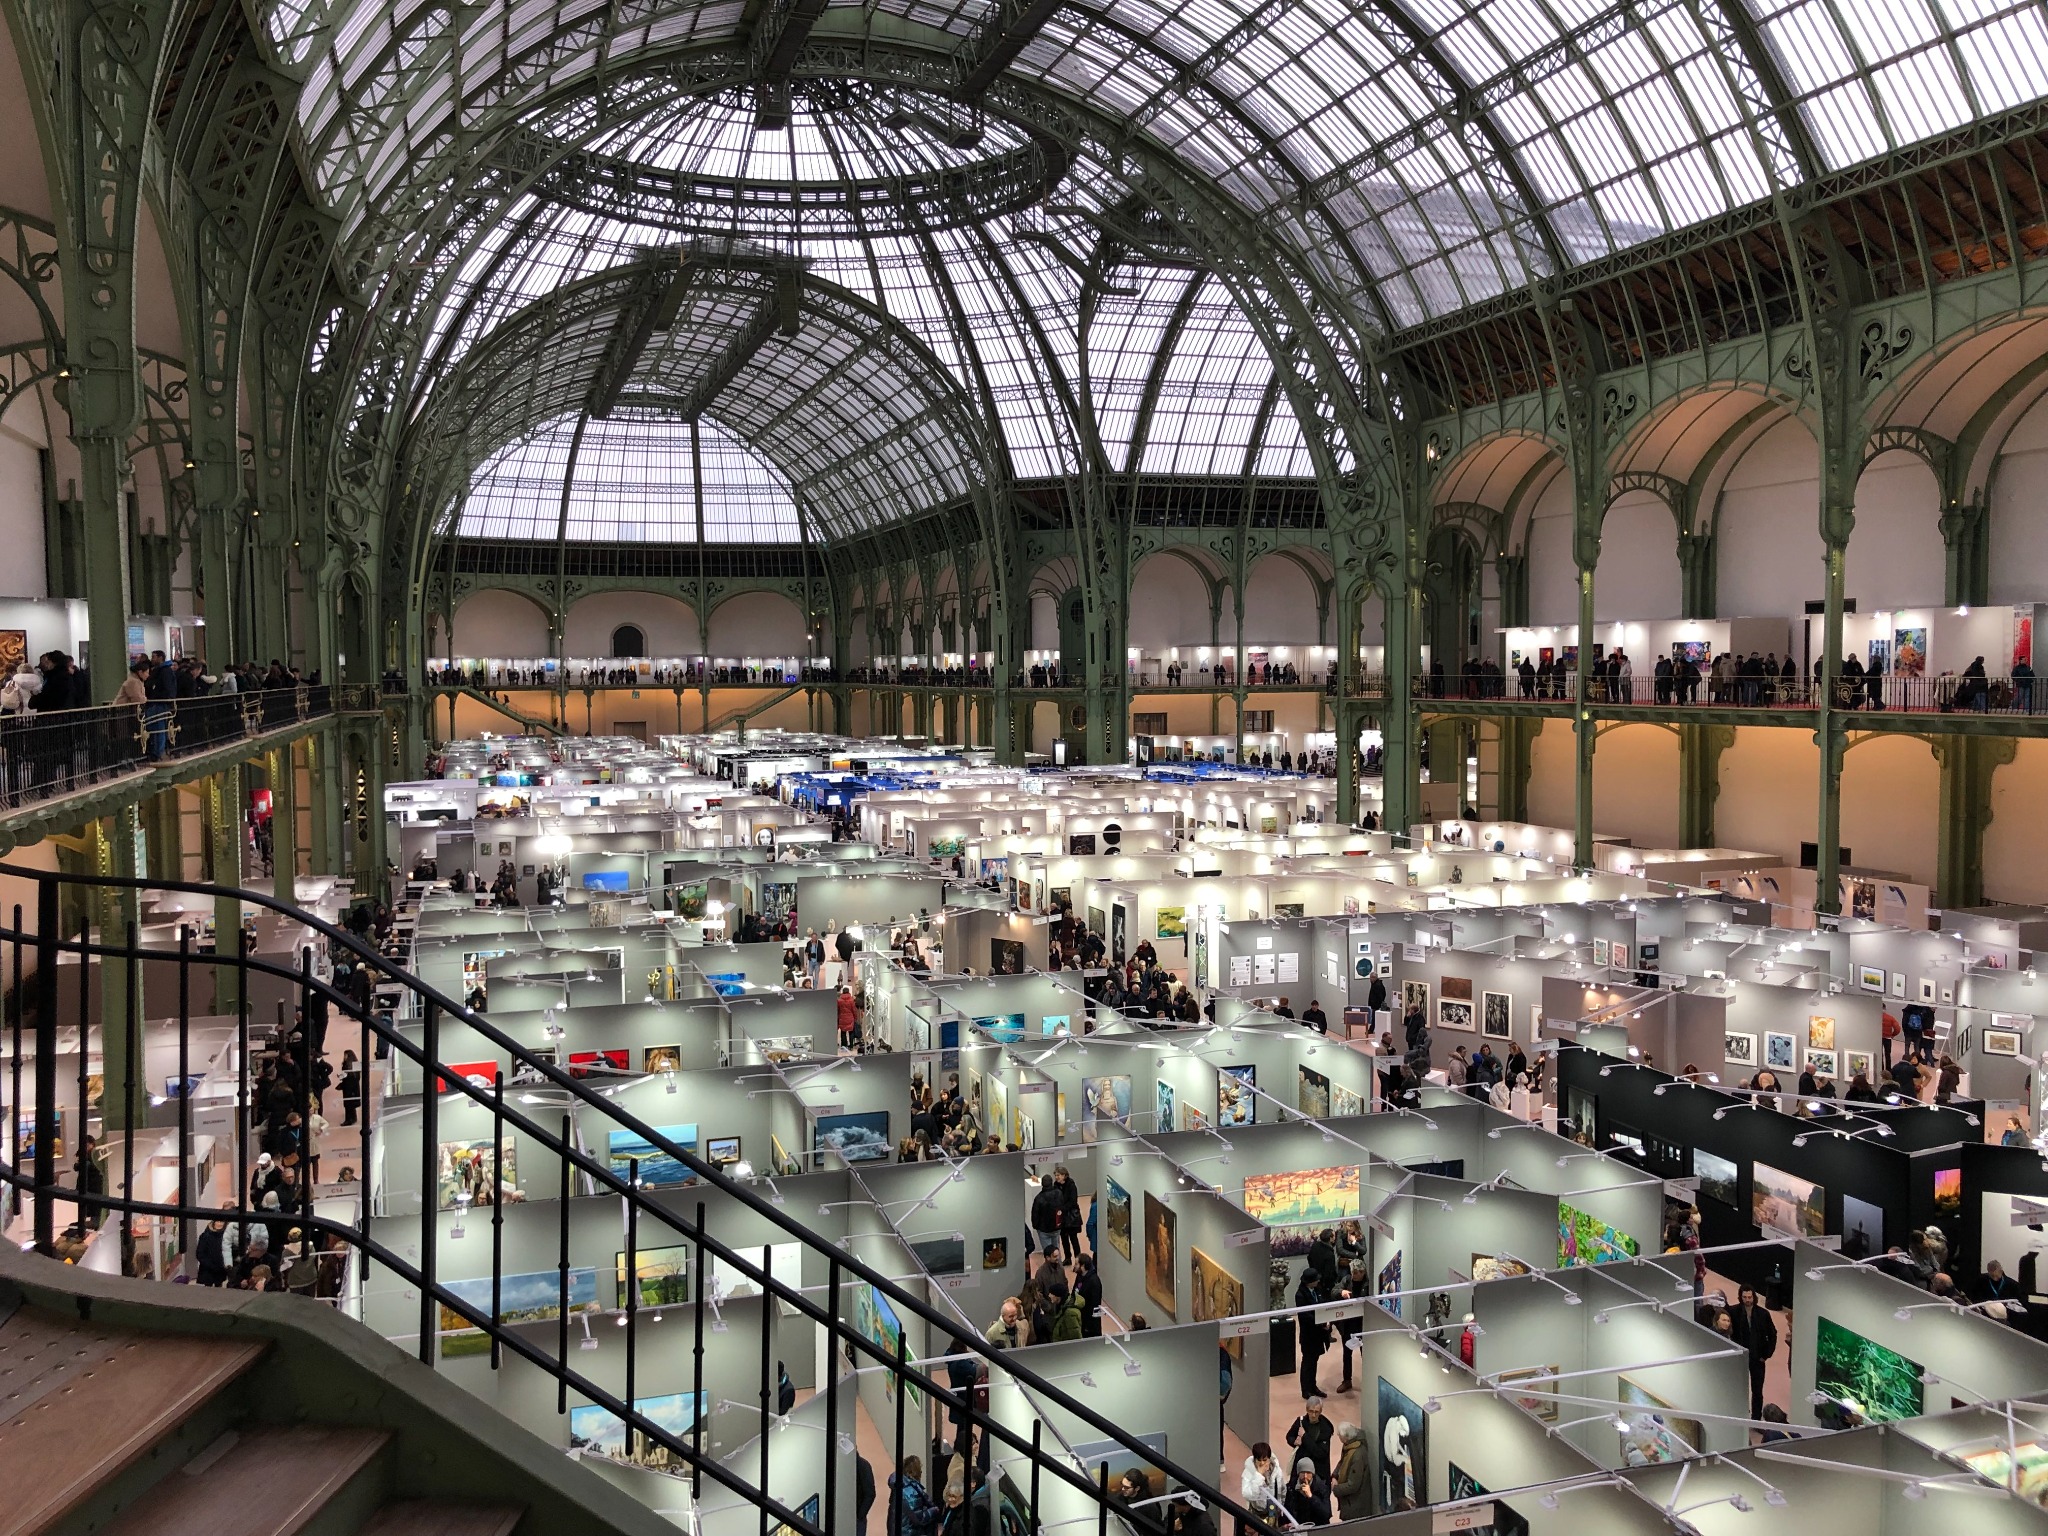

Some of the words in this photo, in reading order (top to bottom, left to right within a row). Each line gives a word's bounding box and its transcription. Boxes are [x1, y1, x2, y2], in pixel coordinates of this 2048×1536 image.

[1335, 1310, 1345, 1318] D9
[1237, 1326, 1250, 1334] C22
[1455, 1517, 1471, 1527] C23
